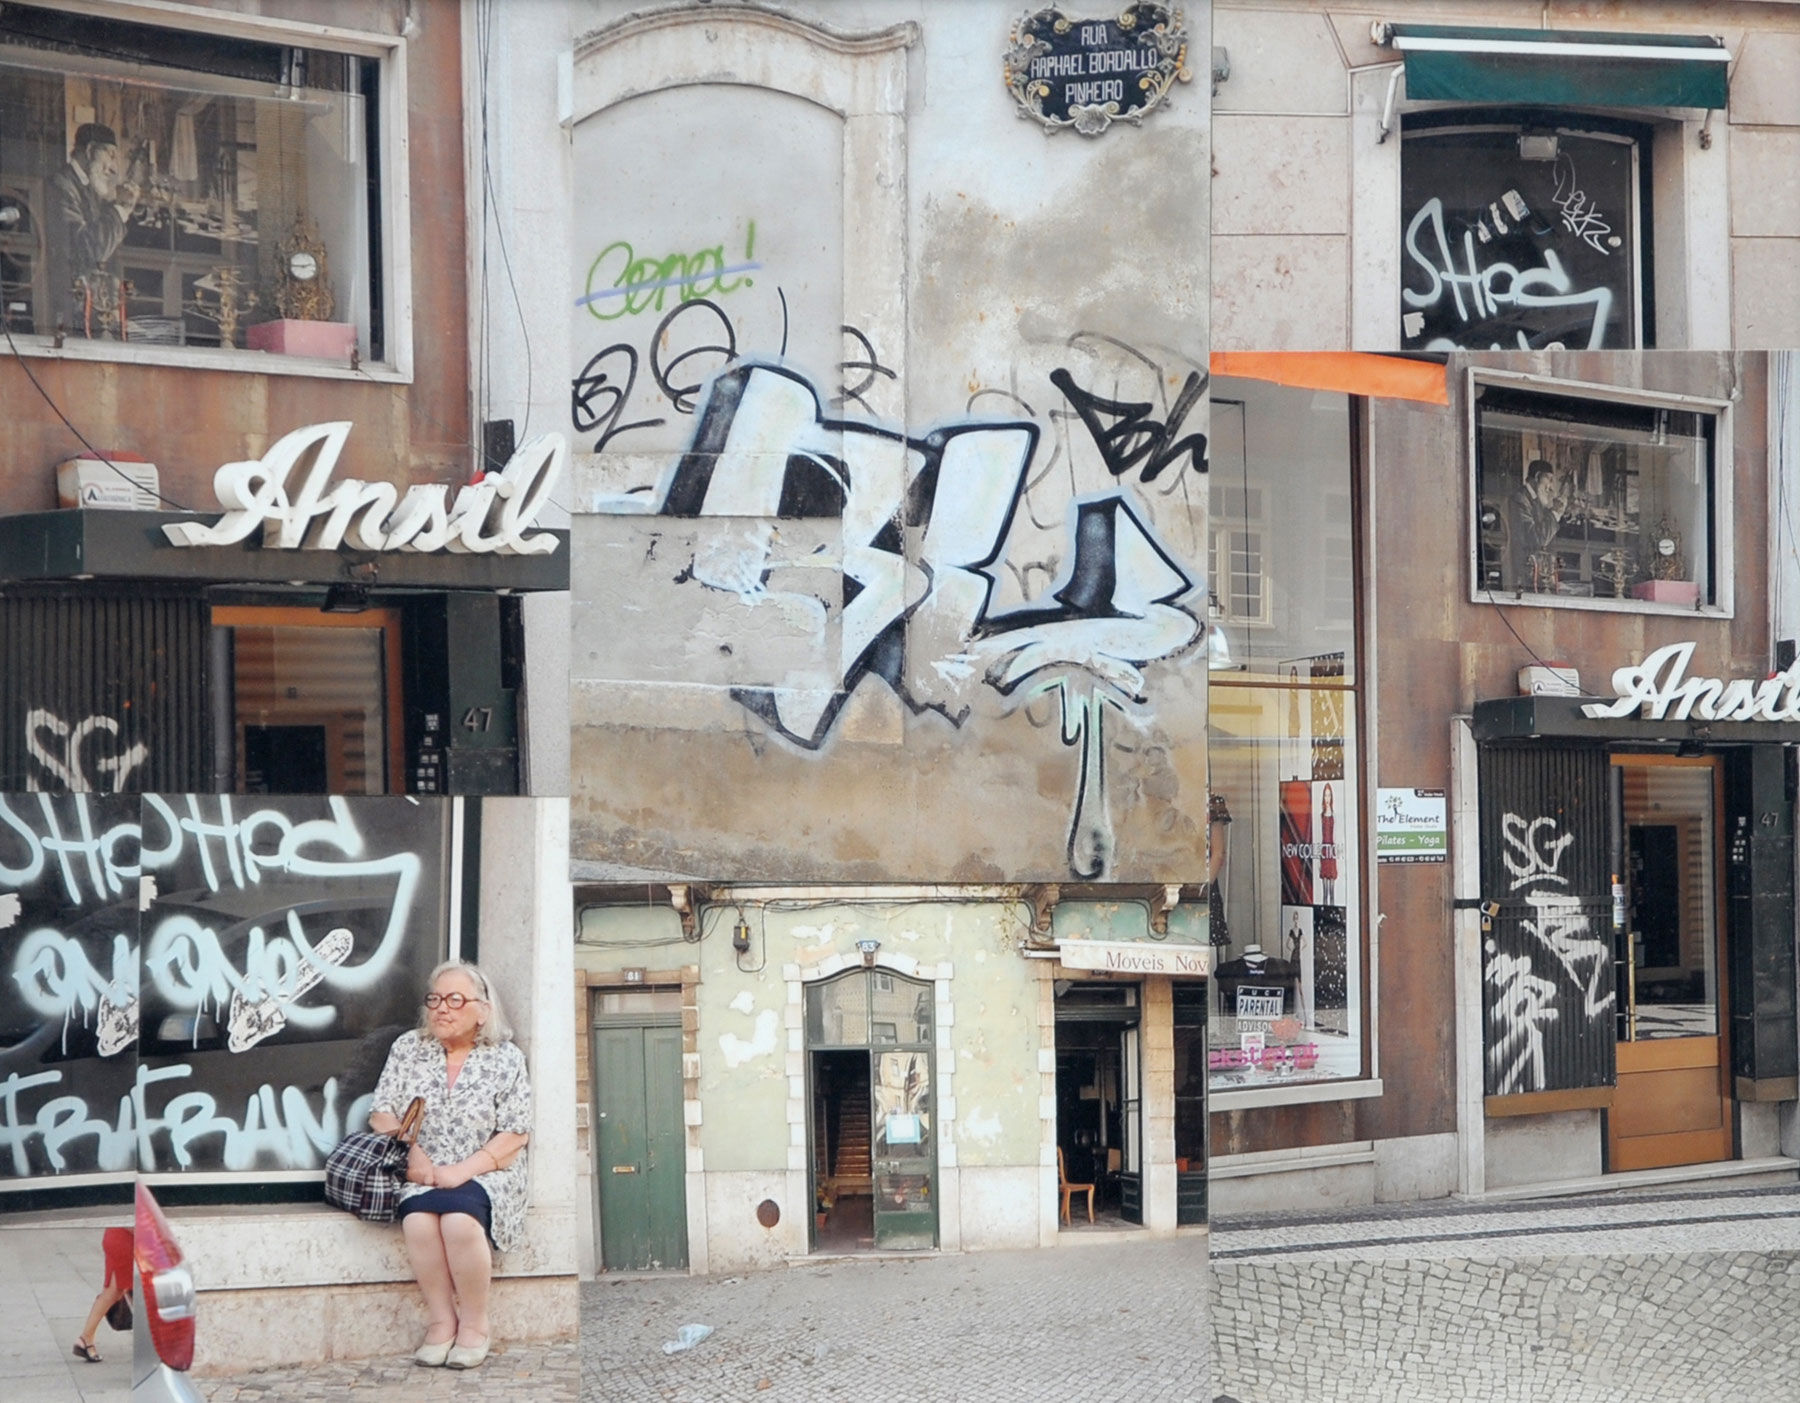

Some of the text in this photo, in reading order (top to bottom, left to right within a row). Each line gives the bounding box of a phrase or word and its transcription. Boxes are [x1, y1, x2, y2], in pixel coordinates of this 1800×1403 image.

[1081, 24, 1108, 46] RUA
[1031, 48, 1157, 78] RAPHAEL BORDALLO
[1065, 79, 1123, 103] PINHEIRO
[161, 421, 565, 554] Ansil
[463, 707, 493, 732] 47
[1377, 813, 1440, 824] The Element
[1761, 811, 1779, 827] 47
[1377, 835, 1406, 846] Pilates
[1418, 834, 1440, 847] Yoga
[1106, 951, 1208, 973] Moveis Nov
[1239, 998, 1279, 1017] PARENTAL
